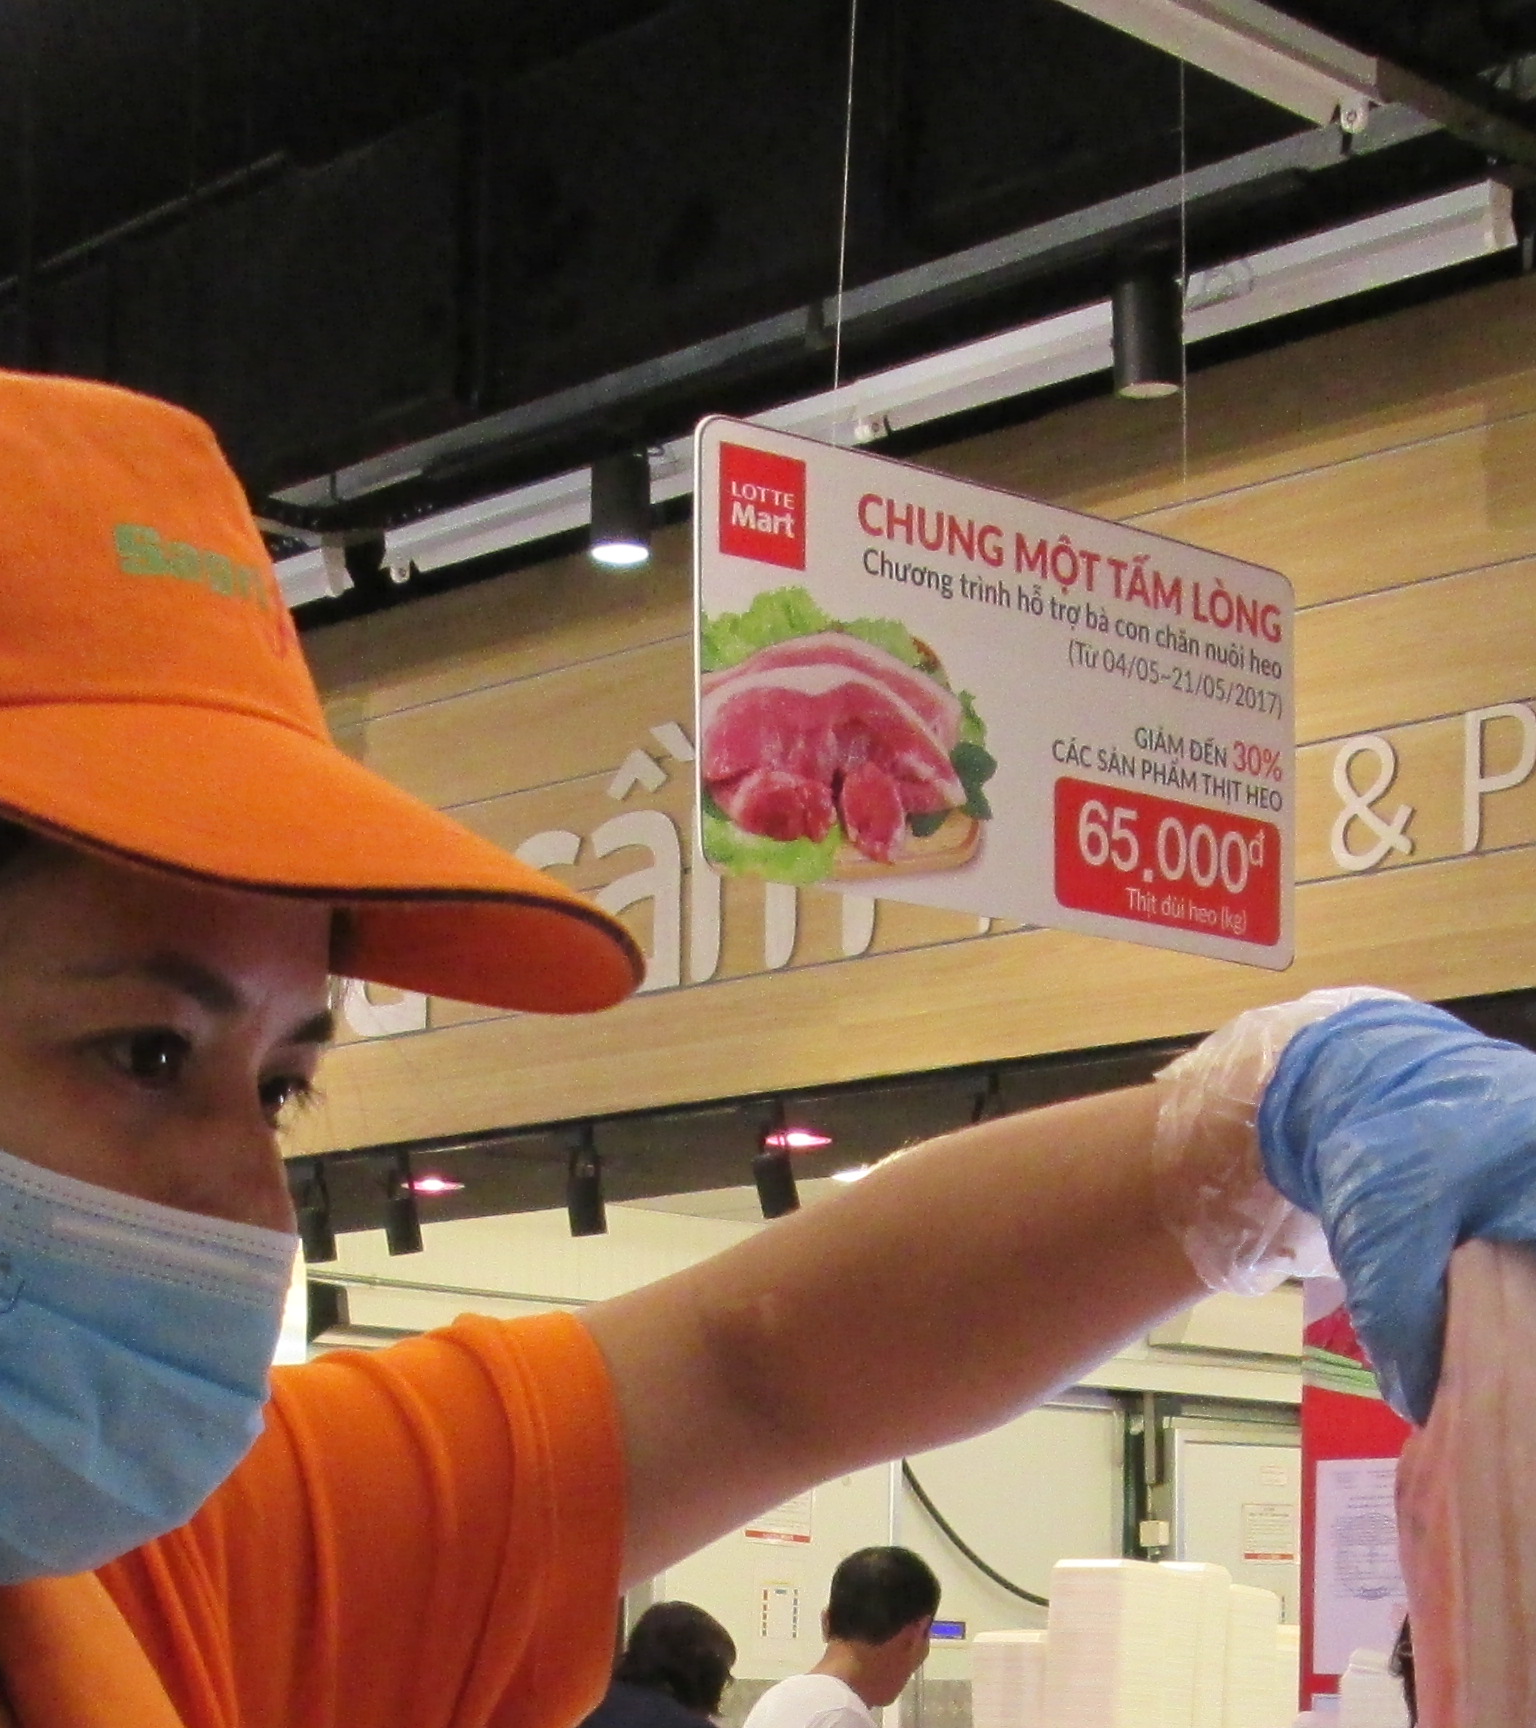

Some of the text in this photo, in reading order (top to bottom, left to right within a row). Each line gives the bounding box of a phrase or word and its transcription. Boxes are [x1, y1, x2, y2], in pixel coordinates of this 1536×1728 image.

[731, 481, 795, 510] LOTTE
[731, 501, 795, 538] Mart
[858, 493, 1004, 567] CHUNG
[1015, 532, 1101, 595] MỘT
[1192, 577, 1282, 643] LÒNG
[864, 548, 1282, 680] Chương trình hỗ trợ bà con chăn nuôi heo
[1068, 640, 1101, 669] (Từ
[1052, 736, 1283, 812] CÁC SẢN PHẨM THỊT HEO
[1134, 727, 1283, 782] GIẢM ĐẾN 30%
[1329, 733, 1416, 873] &
[1125, 887, 1247, 936] Thịt đùi heo (kg)
